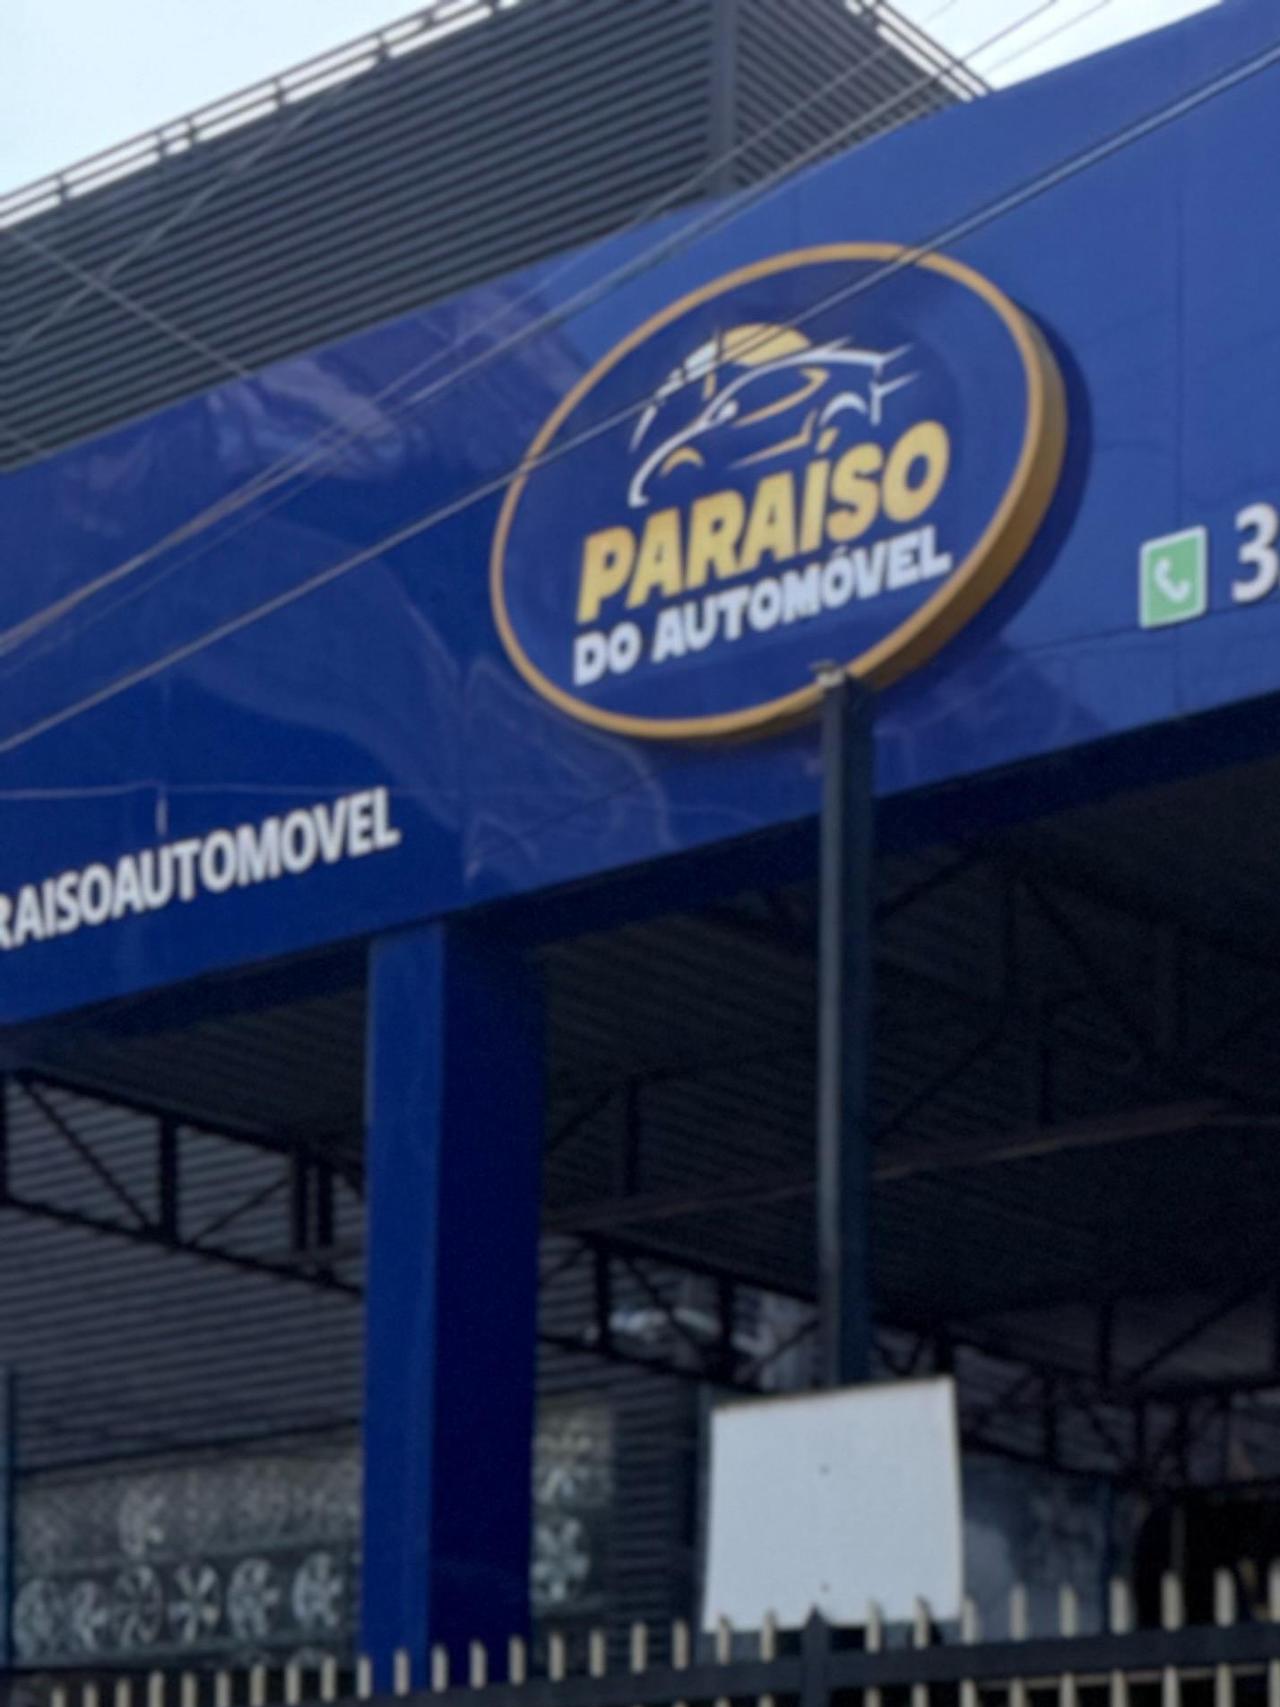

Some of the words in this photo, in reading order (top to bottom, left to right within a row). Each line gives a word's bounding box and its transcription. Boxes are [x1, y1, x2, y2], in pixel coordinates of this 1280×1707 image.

[573, 622, 643, 687] DO
[651, 524, 953, 664] AUTOMÓVEL
[576, 421, 950, 625] PARAÍSO
